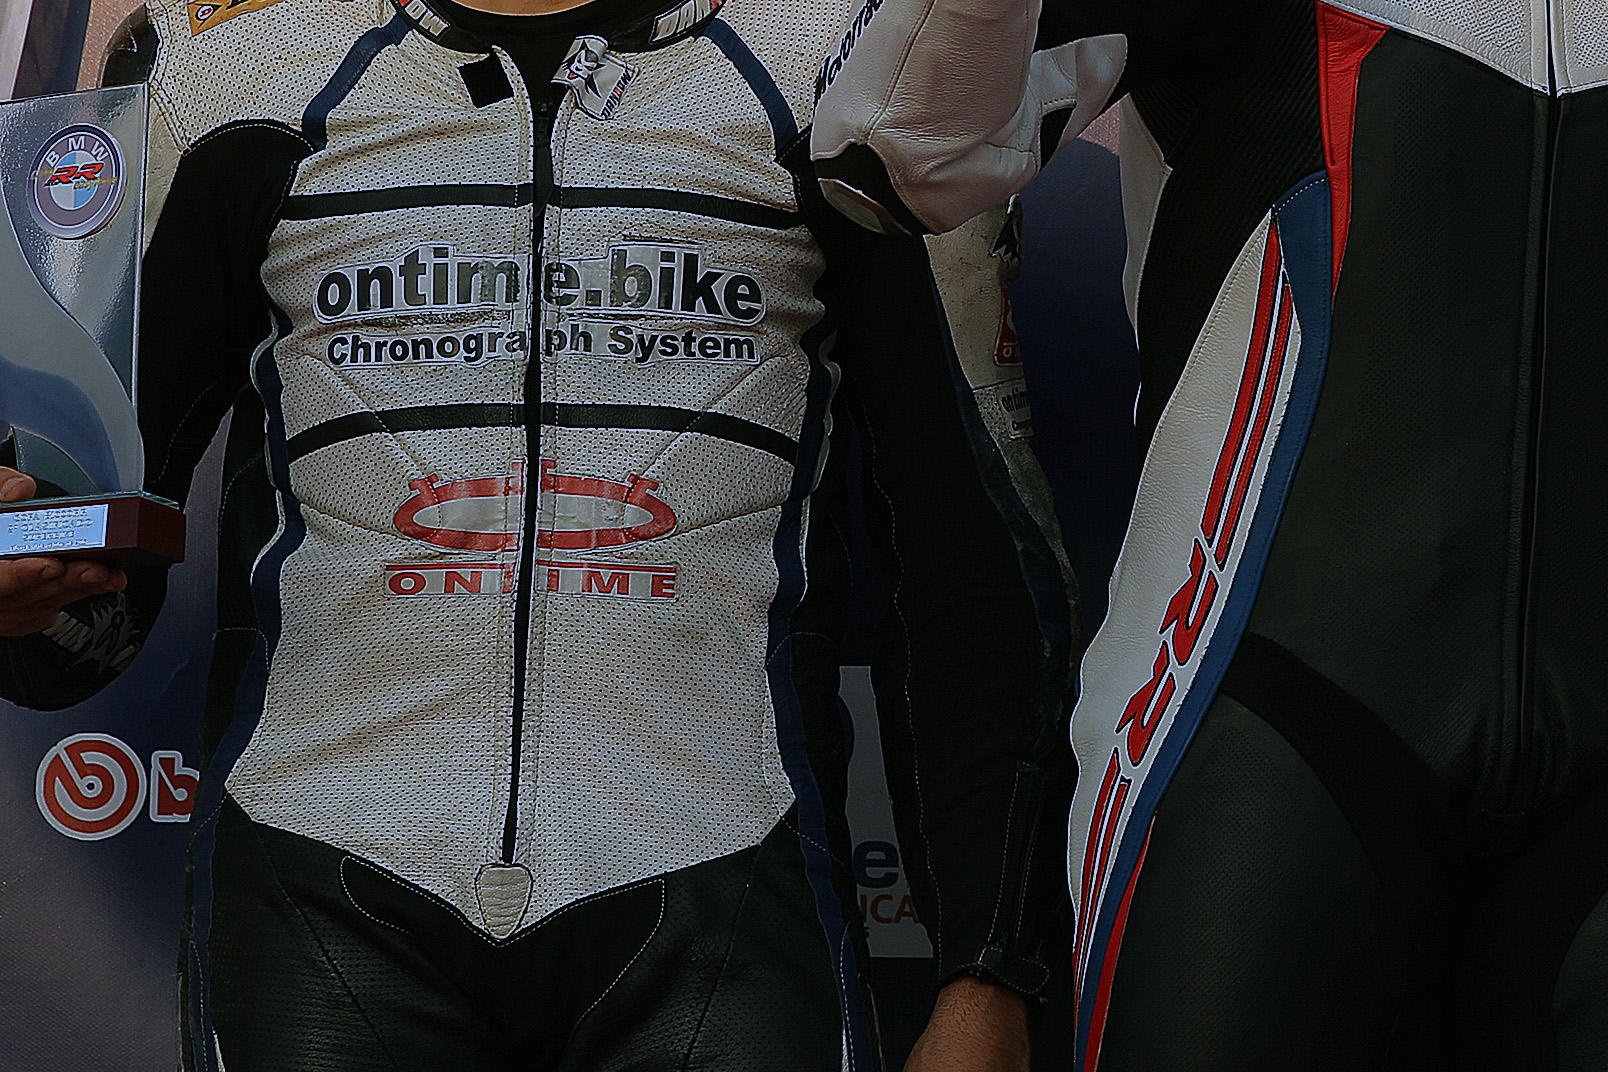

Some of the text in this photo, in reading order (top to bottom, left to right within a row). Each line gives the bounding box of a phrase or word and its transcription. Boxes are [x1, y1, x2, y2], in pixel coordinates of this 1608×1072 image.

[45, 135, 109, 167] BMW
[317, 246, 763, 321] ontime.bike
[326, 325, 756, 365] Chronograph System
